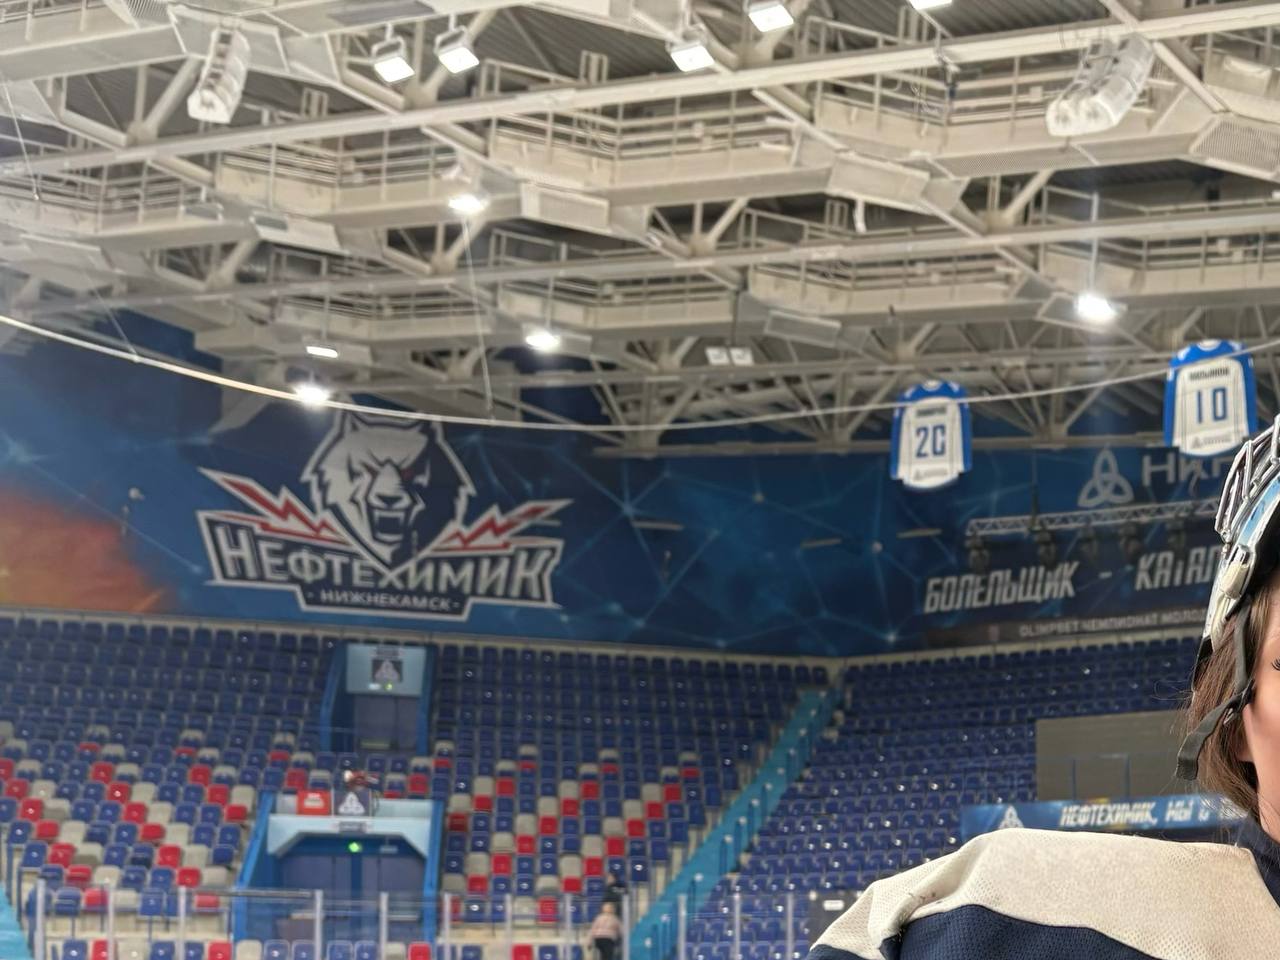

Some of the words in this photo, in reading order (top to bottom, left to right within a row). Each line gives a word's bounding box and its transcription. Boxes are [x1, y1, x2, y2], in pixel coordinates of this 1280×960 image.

[1197, 387, 1227, 424] 10
[214, 525, 553, 598] НЕФТЕХИМИК
[320, 589, 450, 611] НИЖНЕКАМСК
[924, 562, 1079, 613] БОЛЕЛЬЩИК
